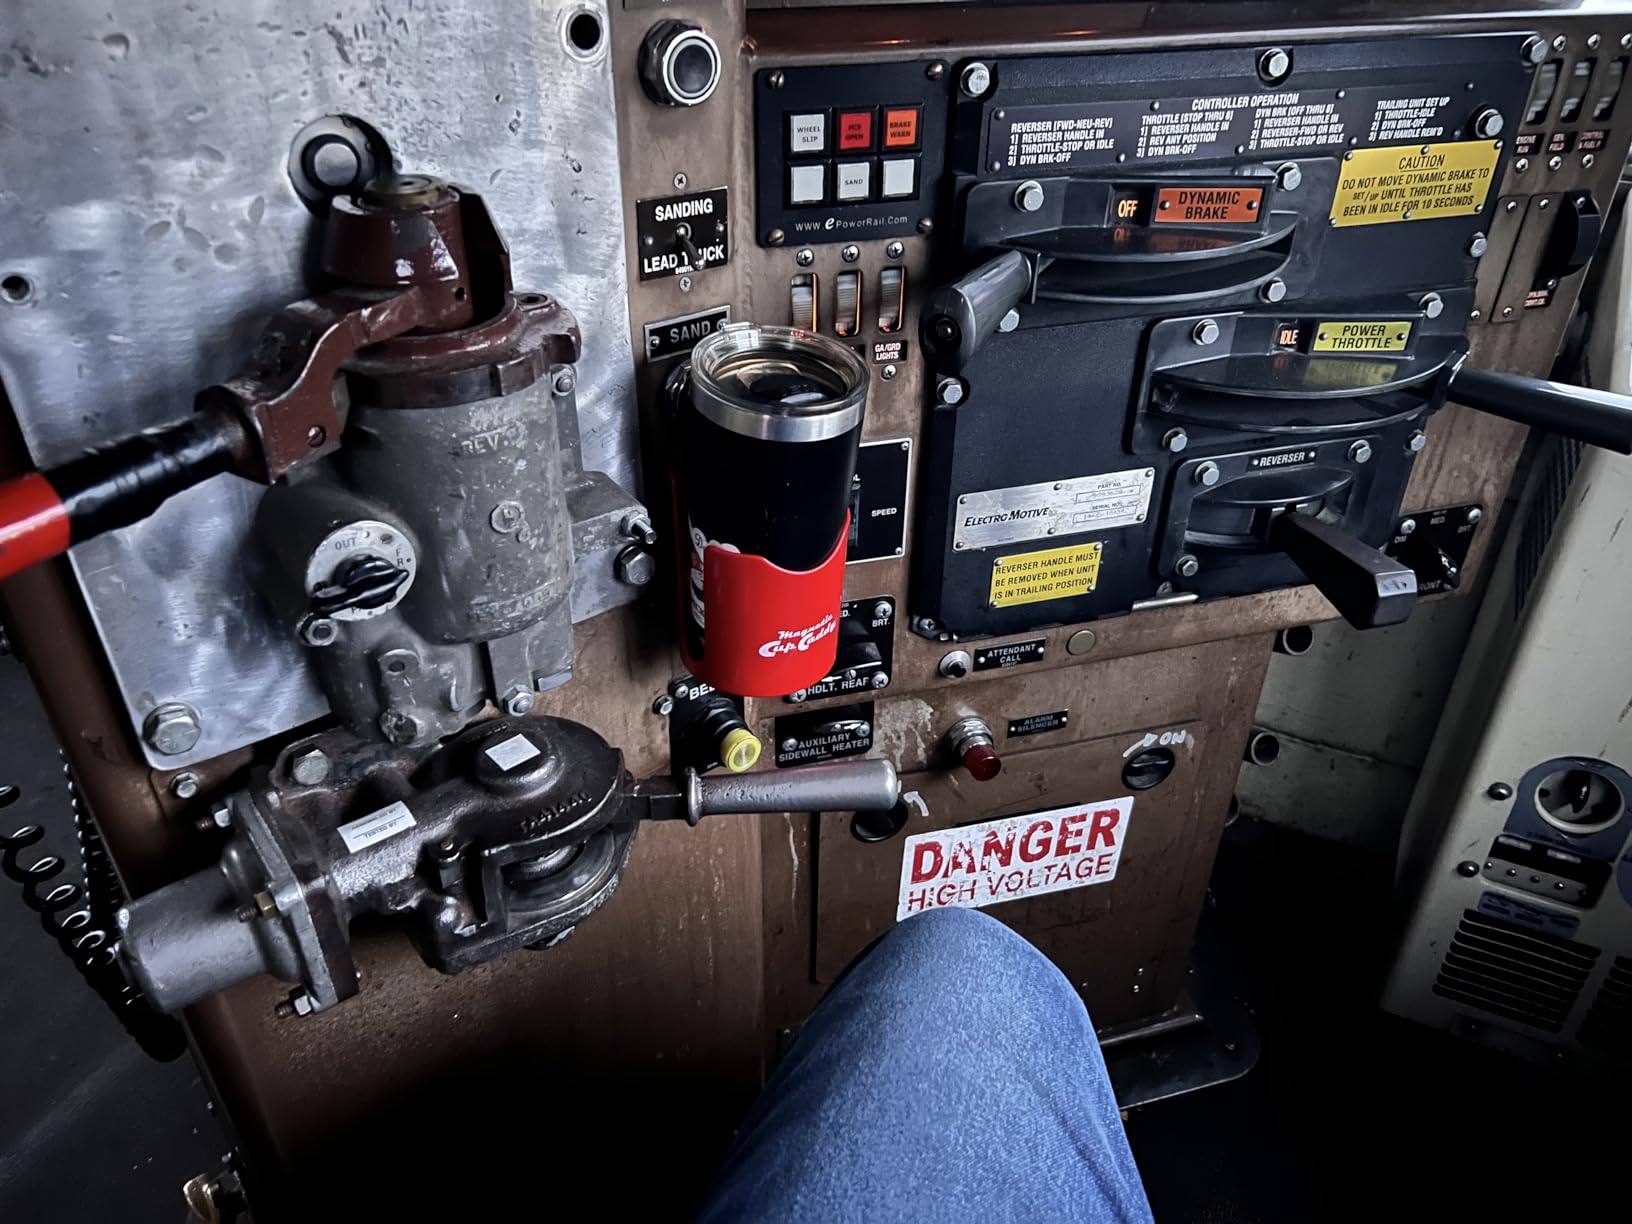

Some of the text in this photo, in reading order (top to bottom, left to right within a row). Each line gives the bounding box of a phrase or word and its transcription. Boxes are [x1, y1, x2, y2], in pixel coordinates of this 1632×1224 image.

[1192, 93, 1300, 111] CONTROLLER OPERATION
[1377, 97, 1450, 110] TRAILING UNIT SET UP
[1142, 114, 1180, 125] THROTTLE
[1204, 111, 1224, 121] THRU
[1255, 108, 1271, 118] DYN
[1272, 107, 1288, 117] BRK
[1306, 104, 1326, 114] THRU
[1011, 122, 1052, 133] REVERSER
[1264, 117, 1301, 128] REVERSER
[1302, 115, 1330, 125] HANDLE
[1330, 114, 1339, 123] IN
[1381, 120, 1397, 130] DYN
[1151, 124, 1190, 135] REVERSER
[1191, 122, 1220, 132] HANDLE
[1221, 122, 1230, 130] IN
[1318, 125, 1328, 134] OR
[1329, 124, 1344, 133] REV
[1379, 130, 1394, 140] REV
[1394, 128, 1421, 139] HANDLE
[1022, 132, 1062, 143] REVERSER
[1064, 129, 1095, 141] HANDLE
[1096, 129, 1105, 138] IN
[1150, 136, 1165, 146] REV
[1165, 135, 1181, 145] ANY
[1182, 133, 1216, 144] POSITION
[1316, 135, 1327, 144] OR
[1328, 134, 1344, 144] IDLE
[1084, 140, 1095, 150] OR
[1097, 139, 1114, 149] IDLE
[1148, 146, 1164, 156] DYN
[1020, 154, 1037, 165] DYN
[1399, 154, 1445, 170] CAUTION
[1342, 168, 1490, 190] DO NOT MOVE DYNAMIC BRAKE TO
[1178, 191, 1240, 205] DYNAMIC
[1381, 188, 1406, 200] UNTIL
[1410, 184, 1452, 197] THROTTLE
[1455, 183, 1472, 193] HAS
[655, 198, 713, 221] SANDING
[1118, 200, 1138, 217] OFF
[1343, 196, 1474, 216] BEEN IN IDLE FOR 10 SECONDS
[1185, 207, 1228, 220] BRAKE
[644, 254, 678, 273] LEAD
[670, 320, 711, 343] SAND
[1280, 330, 1299, 344] IDLE
[1342, 325, 1386, 336] POWER
[1332, 338, 1392, 348] THROTTLE
[876, 351, 898, 360] LIGHTS
[1260, 452, 1305, 466] REVERSER
[871, 508, 897, 517] SPEED
[335, 538, 356, 550] OUT
[996, 552, 1099, 574] REVERSER HANDLE MUST
[996, 565, 1096, 587] BE REMOVED WHEN UNIT
[1005, 590, 1013, 598] IN
[1017, 584, 1053, 596] TRAILING
[1056, 577, 1093, 589] POSITION
[778, 614, 833, 639] Magnetic
[872, 618, 890, 627] BRT.
[758, 620, 836, 657] Cup Caddy
[988, 644, 1036, 657] ATTENDANT
[1000, 654, 1021, 663] CALL
[808, 683, 837, 695] HDLT.
[1017, 720, 1058, 732] SILENCER
[1024, 715, 1054, 725] ALARM
[798, 733, 850, 749] AUXILIARY
[1160, 730, 1186, 745] ON
[779, 738, 870, 762] SIDEWALL HEATER
[910, 808, 1120, 884] DANGER
[908, 854, 1116, 912] HIGH VOLTAGE
